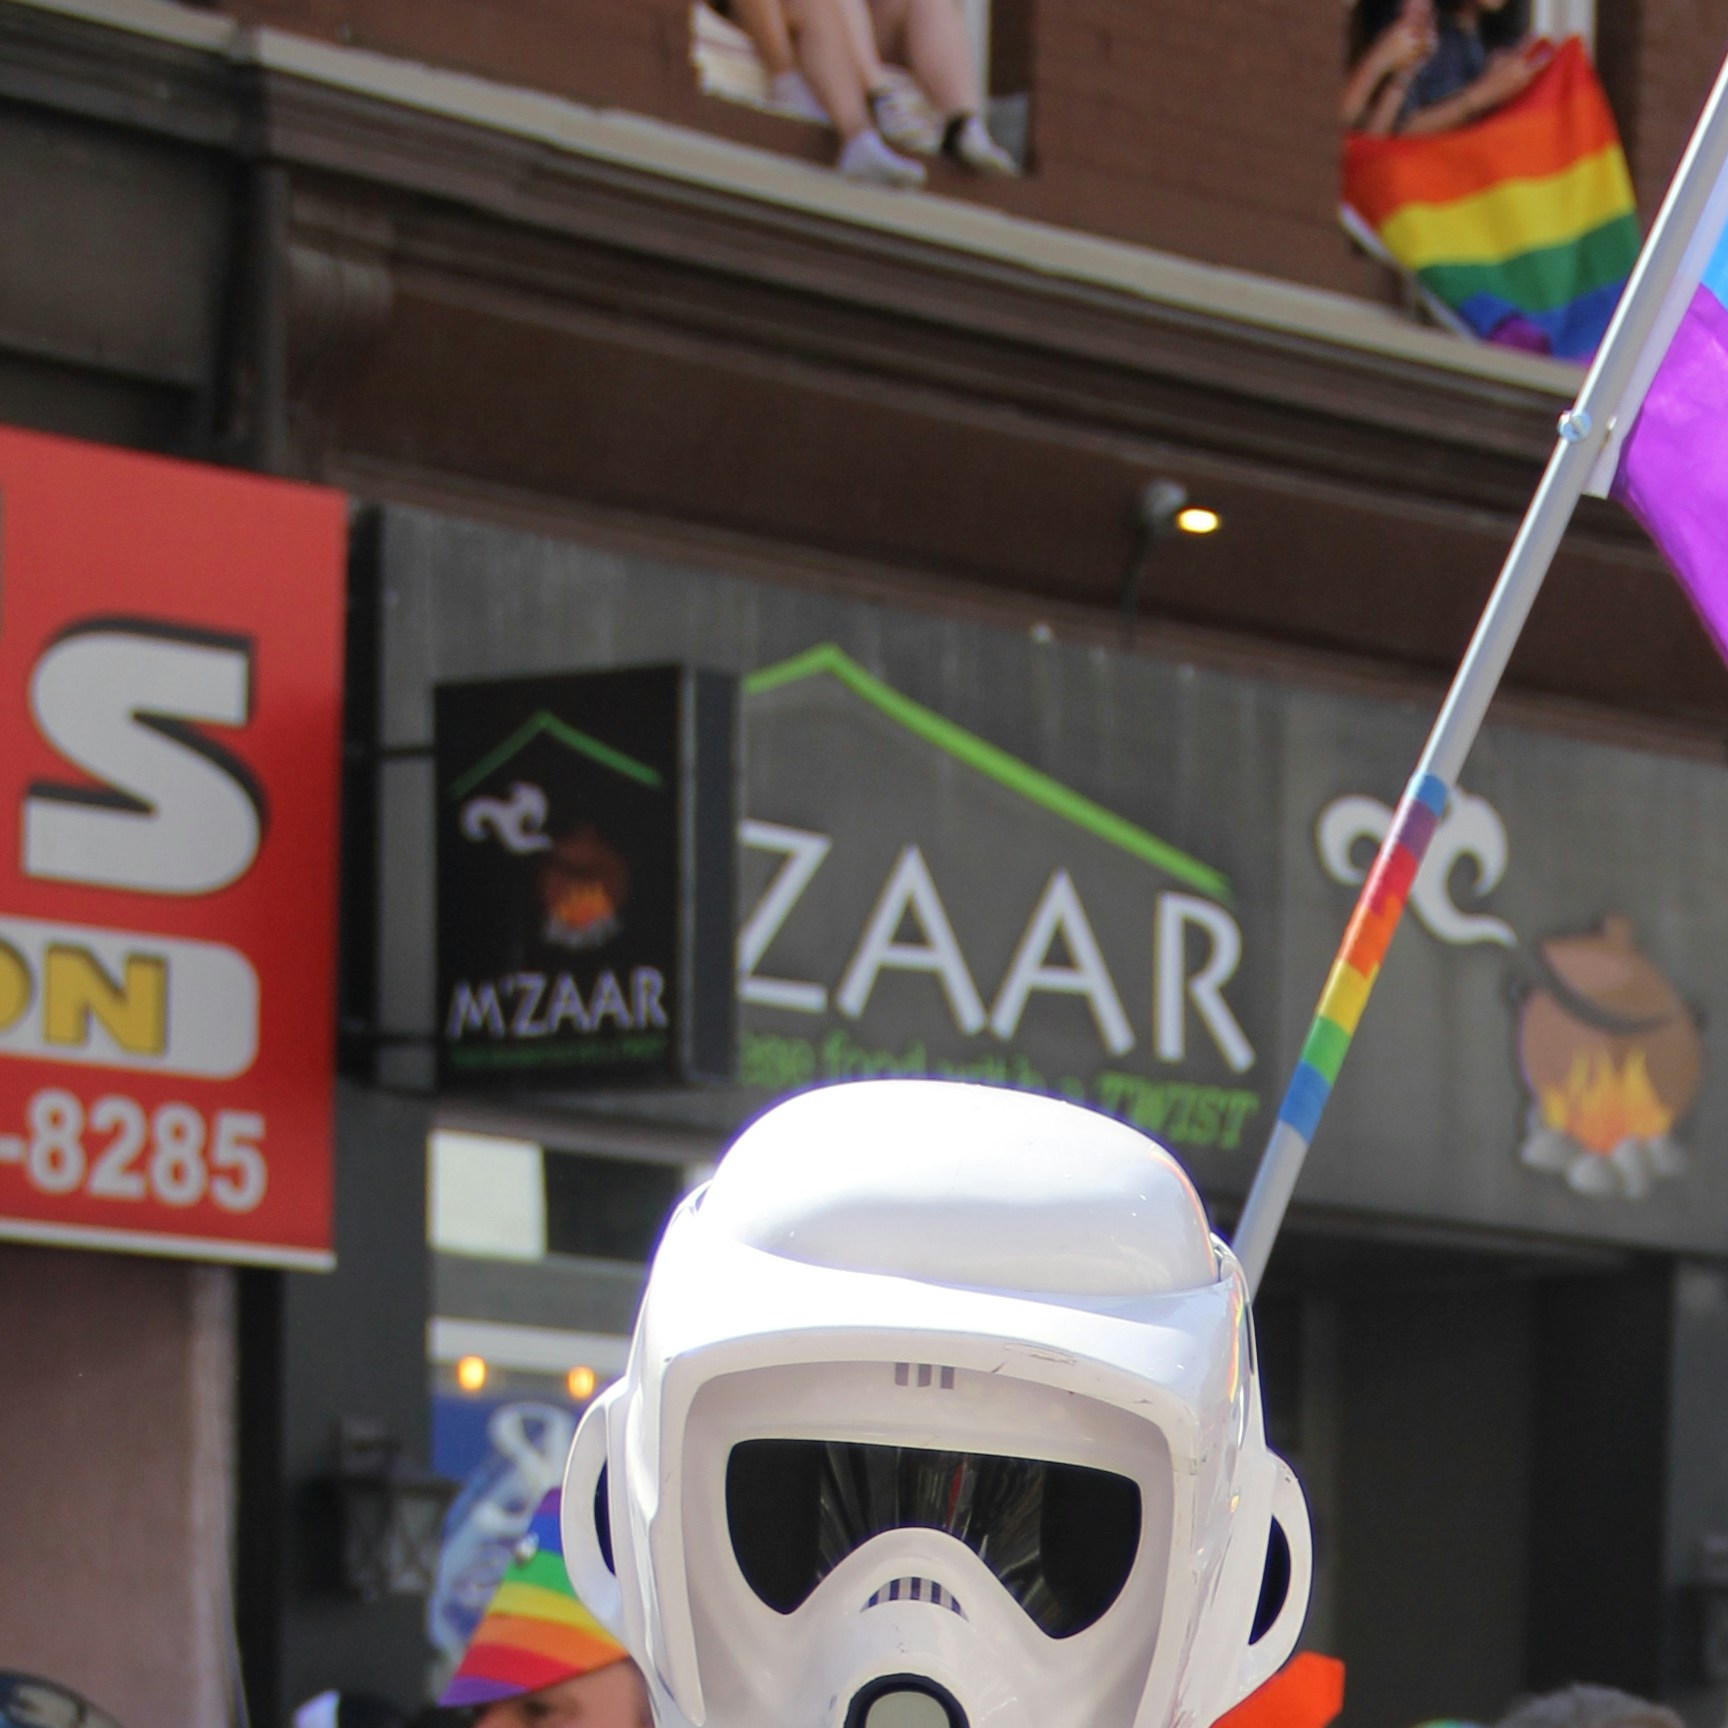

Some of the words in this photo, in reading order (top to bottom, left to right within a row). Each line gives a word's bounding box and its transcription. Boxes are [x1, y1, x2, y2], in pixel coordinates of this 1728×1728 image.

[22, 614, 268, 896] S
[449, 965, 668, 1039] M'ZAAR
[738, 817, 1256, 1073] ZAAR
